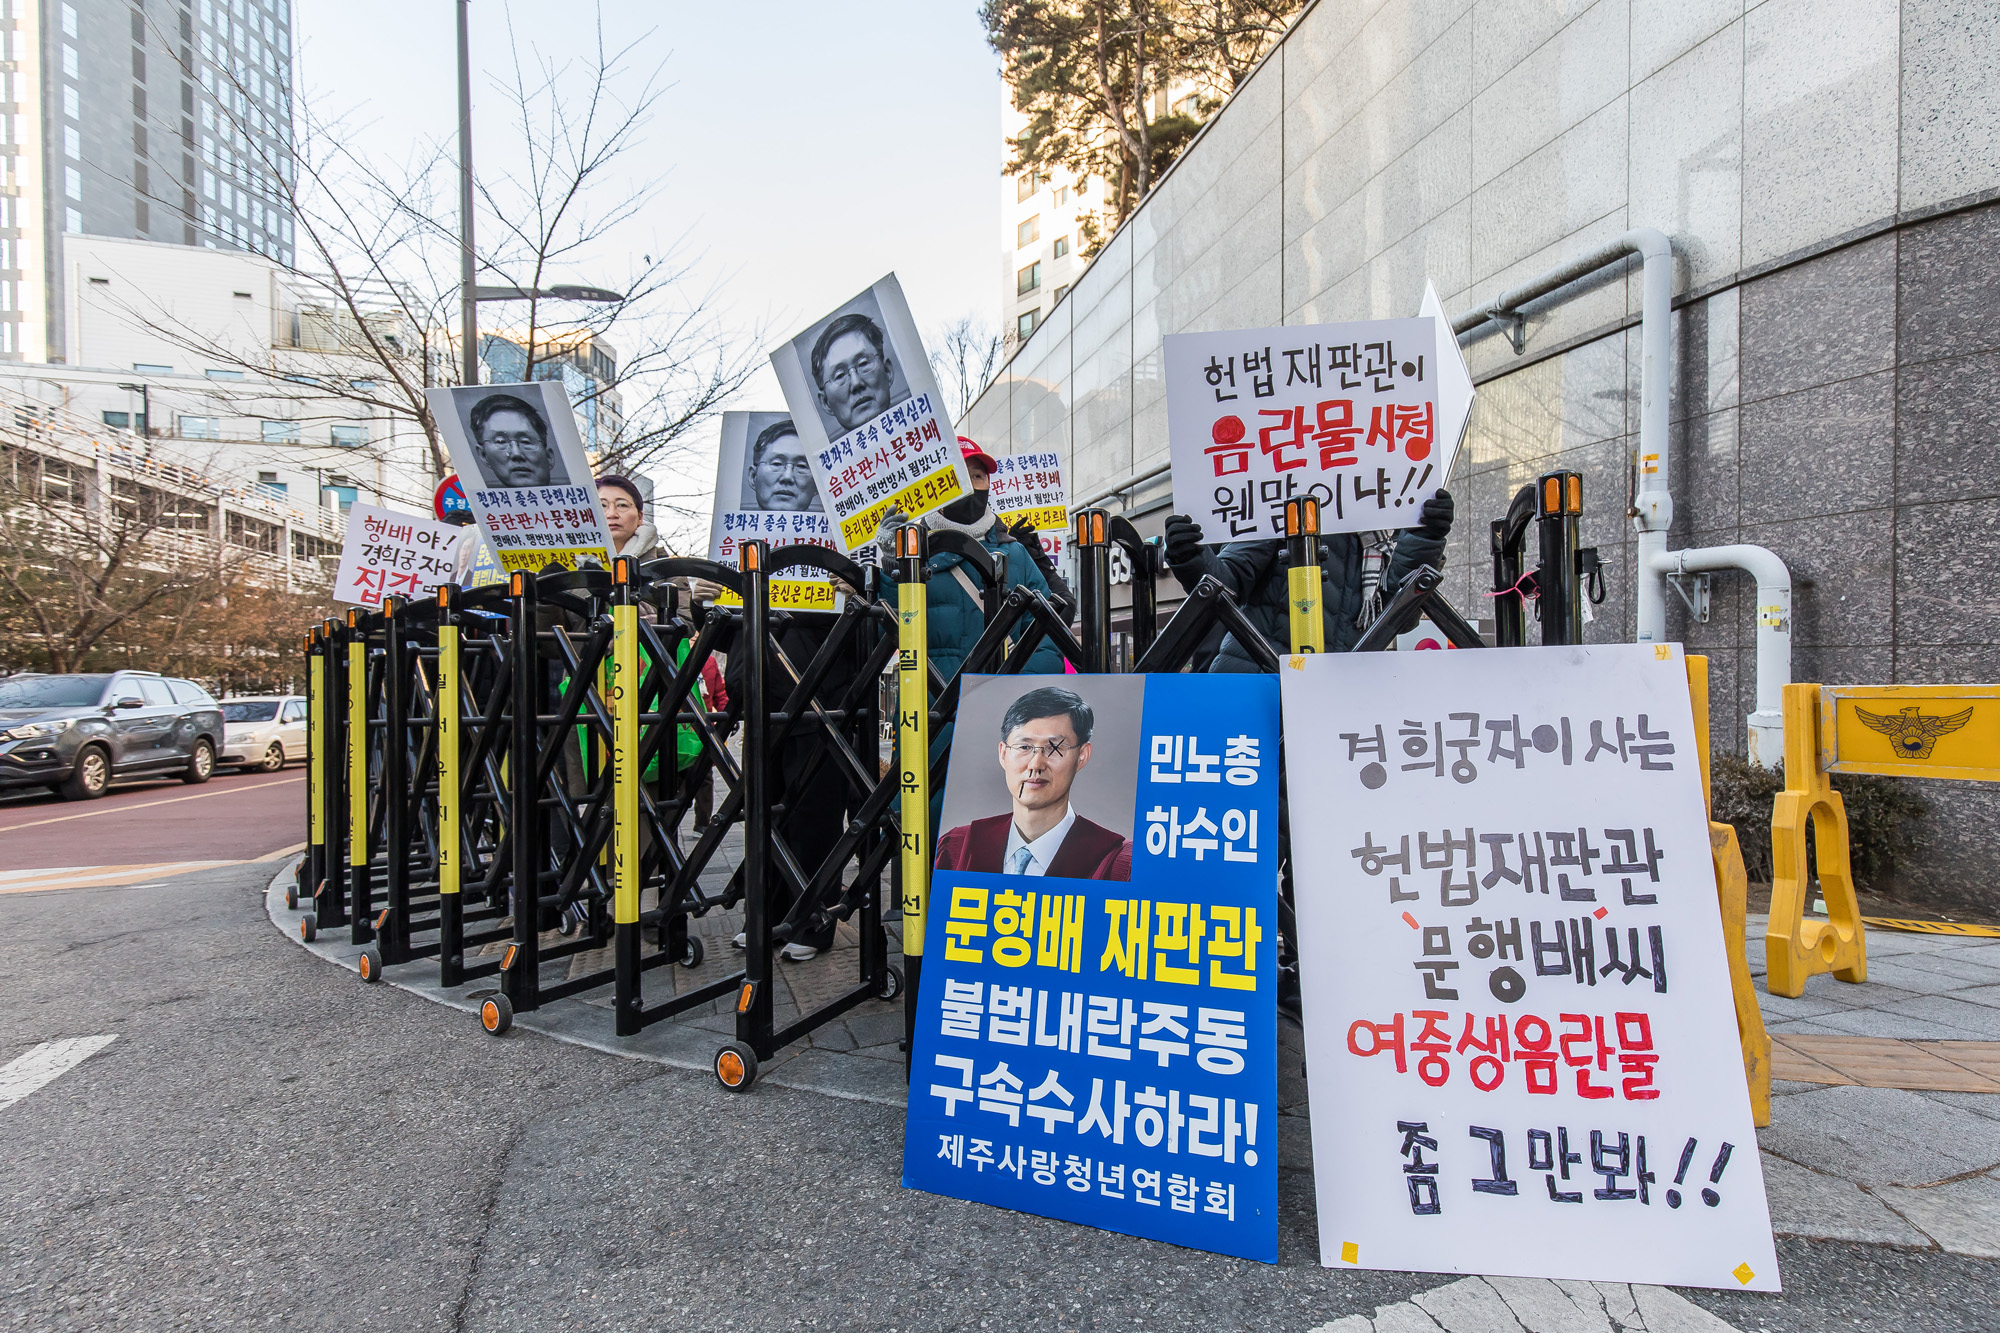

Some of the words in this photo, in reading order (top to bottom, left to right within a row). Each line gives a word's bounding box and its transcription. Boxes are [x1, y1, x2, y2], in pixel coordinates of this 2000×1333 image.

[856, 424, 878, 450] 졸속
[880, 393, 933, 435] 탄핵심리
[924, 468, 960, 501] 다르네
[988, 470, 1062, 497] 판사문형배
[1018, 452, 1058, 471] 탄핵심리
[445, 497, 470, 509] 주정
[515, 490, 539, 507] 졸속
[540, 486, 590, 506] 탄핵심리
[763, 513, 788, 532] 졸속
[792, 513, 830, 534] 탄핵심
[1043, 508, 1068, 525] 다르네
[769, 583, 801, 603] 출신은
[804, 585, 836, 605] 다르네
[614, 663, 624, 784] POLICE
[1584, 713, 1677, 773] 사는
[1149, 734, 1262, 786] 민노총
[1145, 804, 1259, 864] 하수인
[1351, 826, 1665, 907] 헌법재판관
[944, 886, 1086, 975] 문형배
[1100, 898, 1263, 992] 재판관
[939, 978, 1249, 1076] 불법내란주동
[1346, 1009, 1662, 1101] 여중생음란물
[929, 1053, 1260, 1169] 구속수사하라!
[936, 1132, 1237, 1223] 제주사랑청년연합회
[1395, 1119, 1443, 1216] 좀
